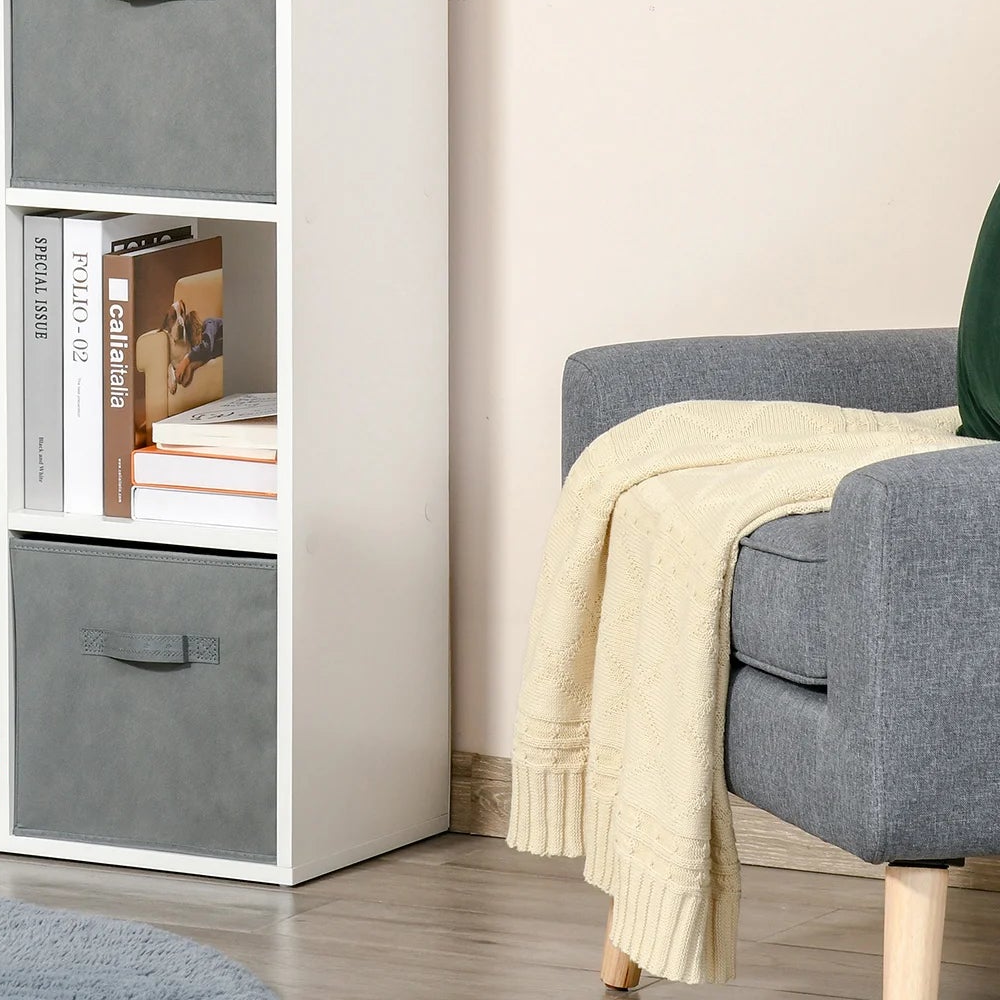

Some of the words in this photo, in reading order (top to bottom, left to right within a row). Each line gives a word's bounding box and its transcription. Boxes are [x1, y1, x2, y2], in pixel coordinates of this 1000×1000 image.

[34, 237, 48, 294] SPECIAL
[72, 251, 89, 323] FOLIO
[34, 300, 48, 340] ISSUE
[109, 304, 129, 409] caliaitalia
